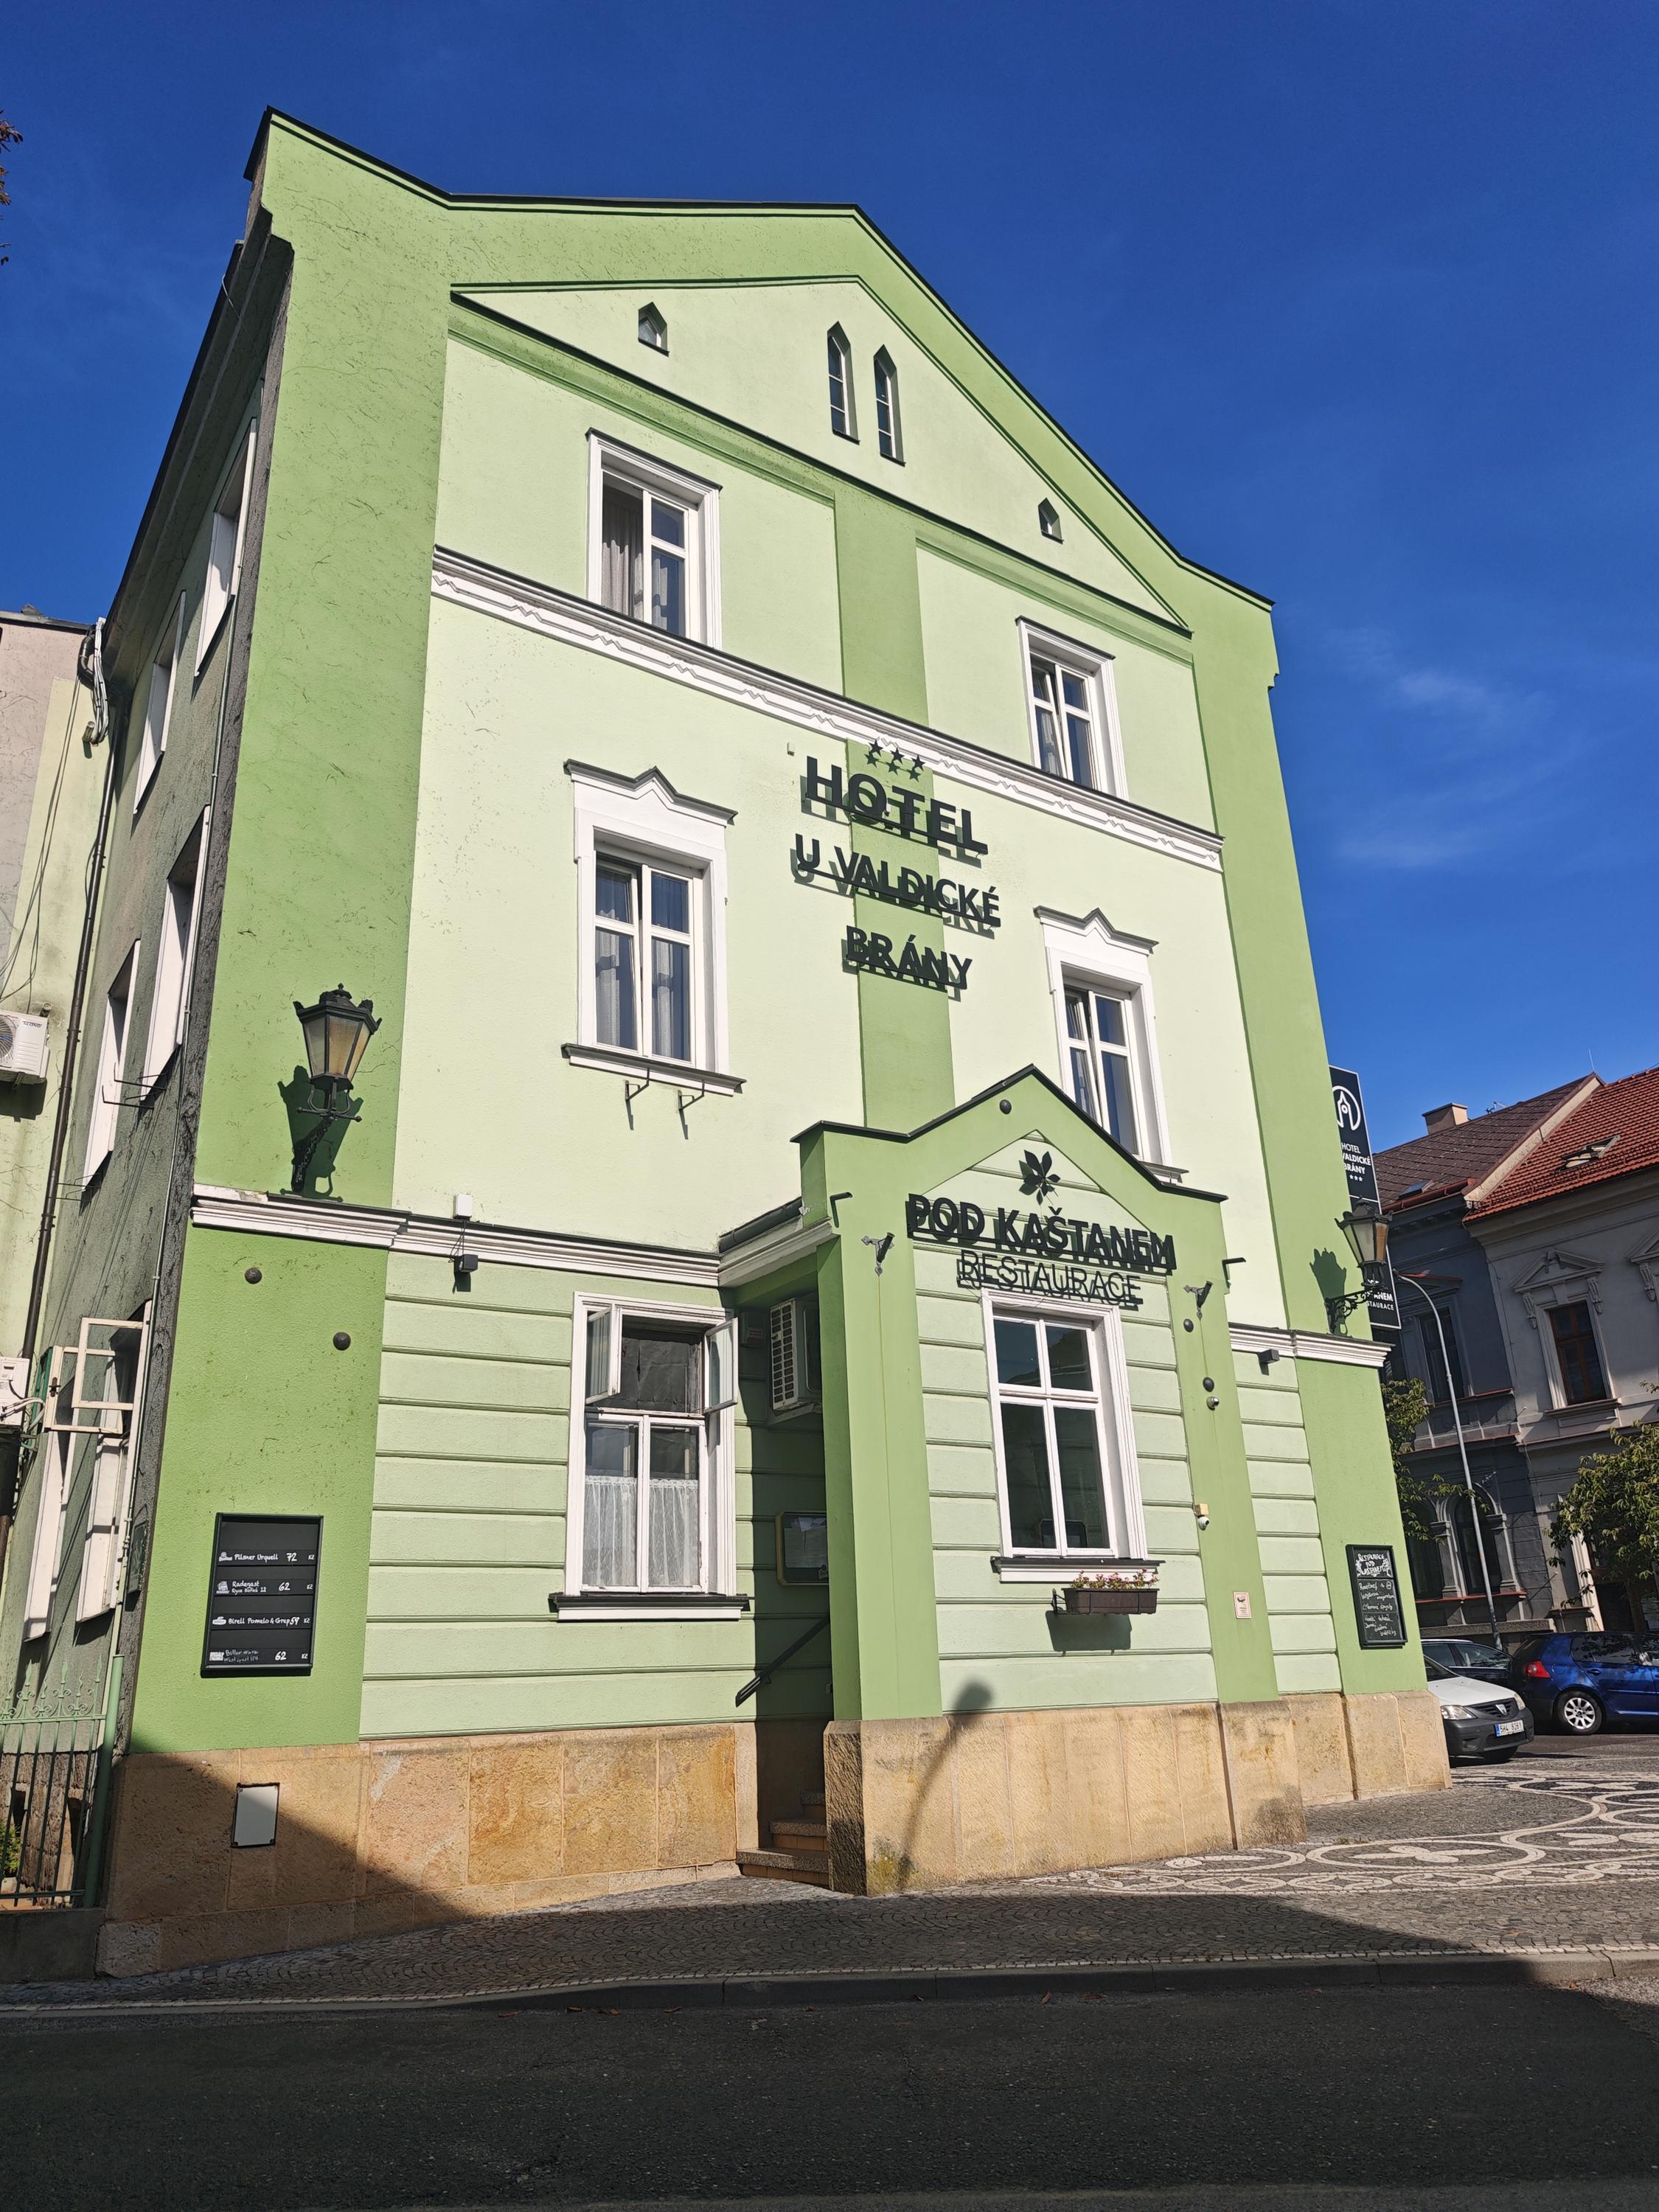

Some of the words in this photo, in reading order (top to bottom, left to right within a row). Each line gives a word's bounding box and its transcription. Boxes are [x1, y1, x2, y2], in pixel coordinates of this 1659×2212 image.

[805, 755, 988, 855] HOTEL
[796, 833, 821, 870] U
[833, 845, 1001, 928] VALDICKÉ
[845, 925, 973, 990] BRÁNY
[1341, 1142, 1361, 1154] HOTEL
[908, 1193, 985, 1239] POD
[998, 1205, 1178, 1270] KAŠTANEM
[959, 1249, 1144, 1305] RESTAURACE
[1366, 1301, 1394, 1311] STAURACE
[257, 1554, 279, 1563] Urquell
[286, 1552, 298, 1562] 72
[232, 1580, 260, 1590] Radegast
[278, 1582, 291, 1591] 62
[290, 1616, 300, 1625] 59
[274, 1651, 287, 1660] 62
